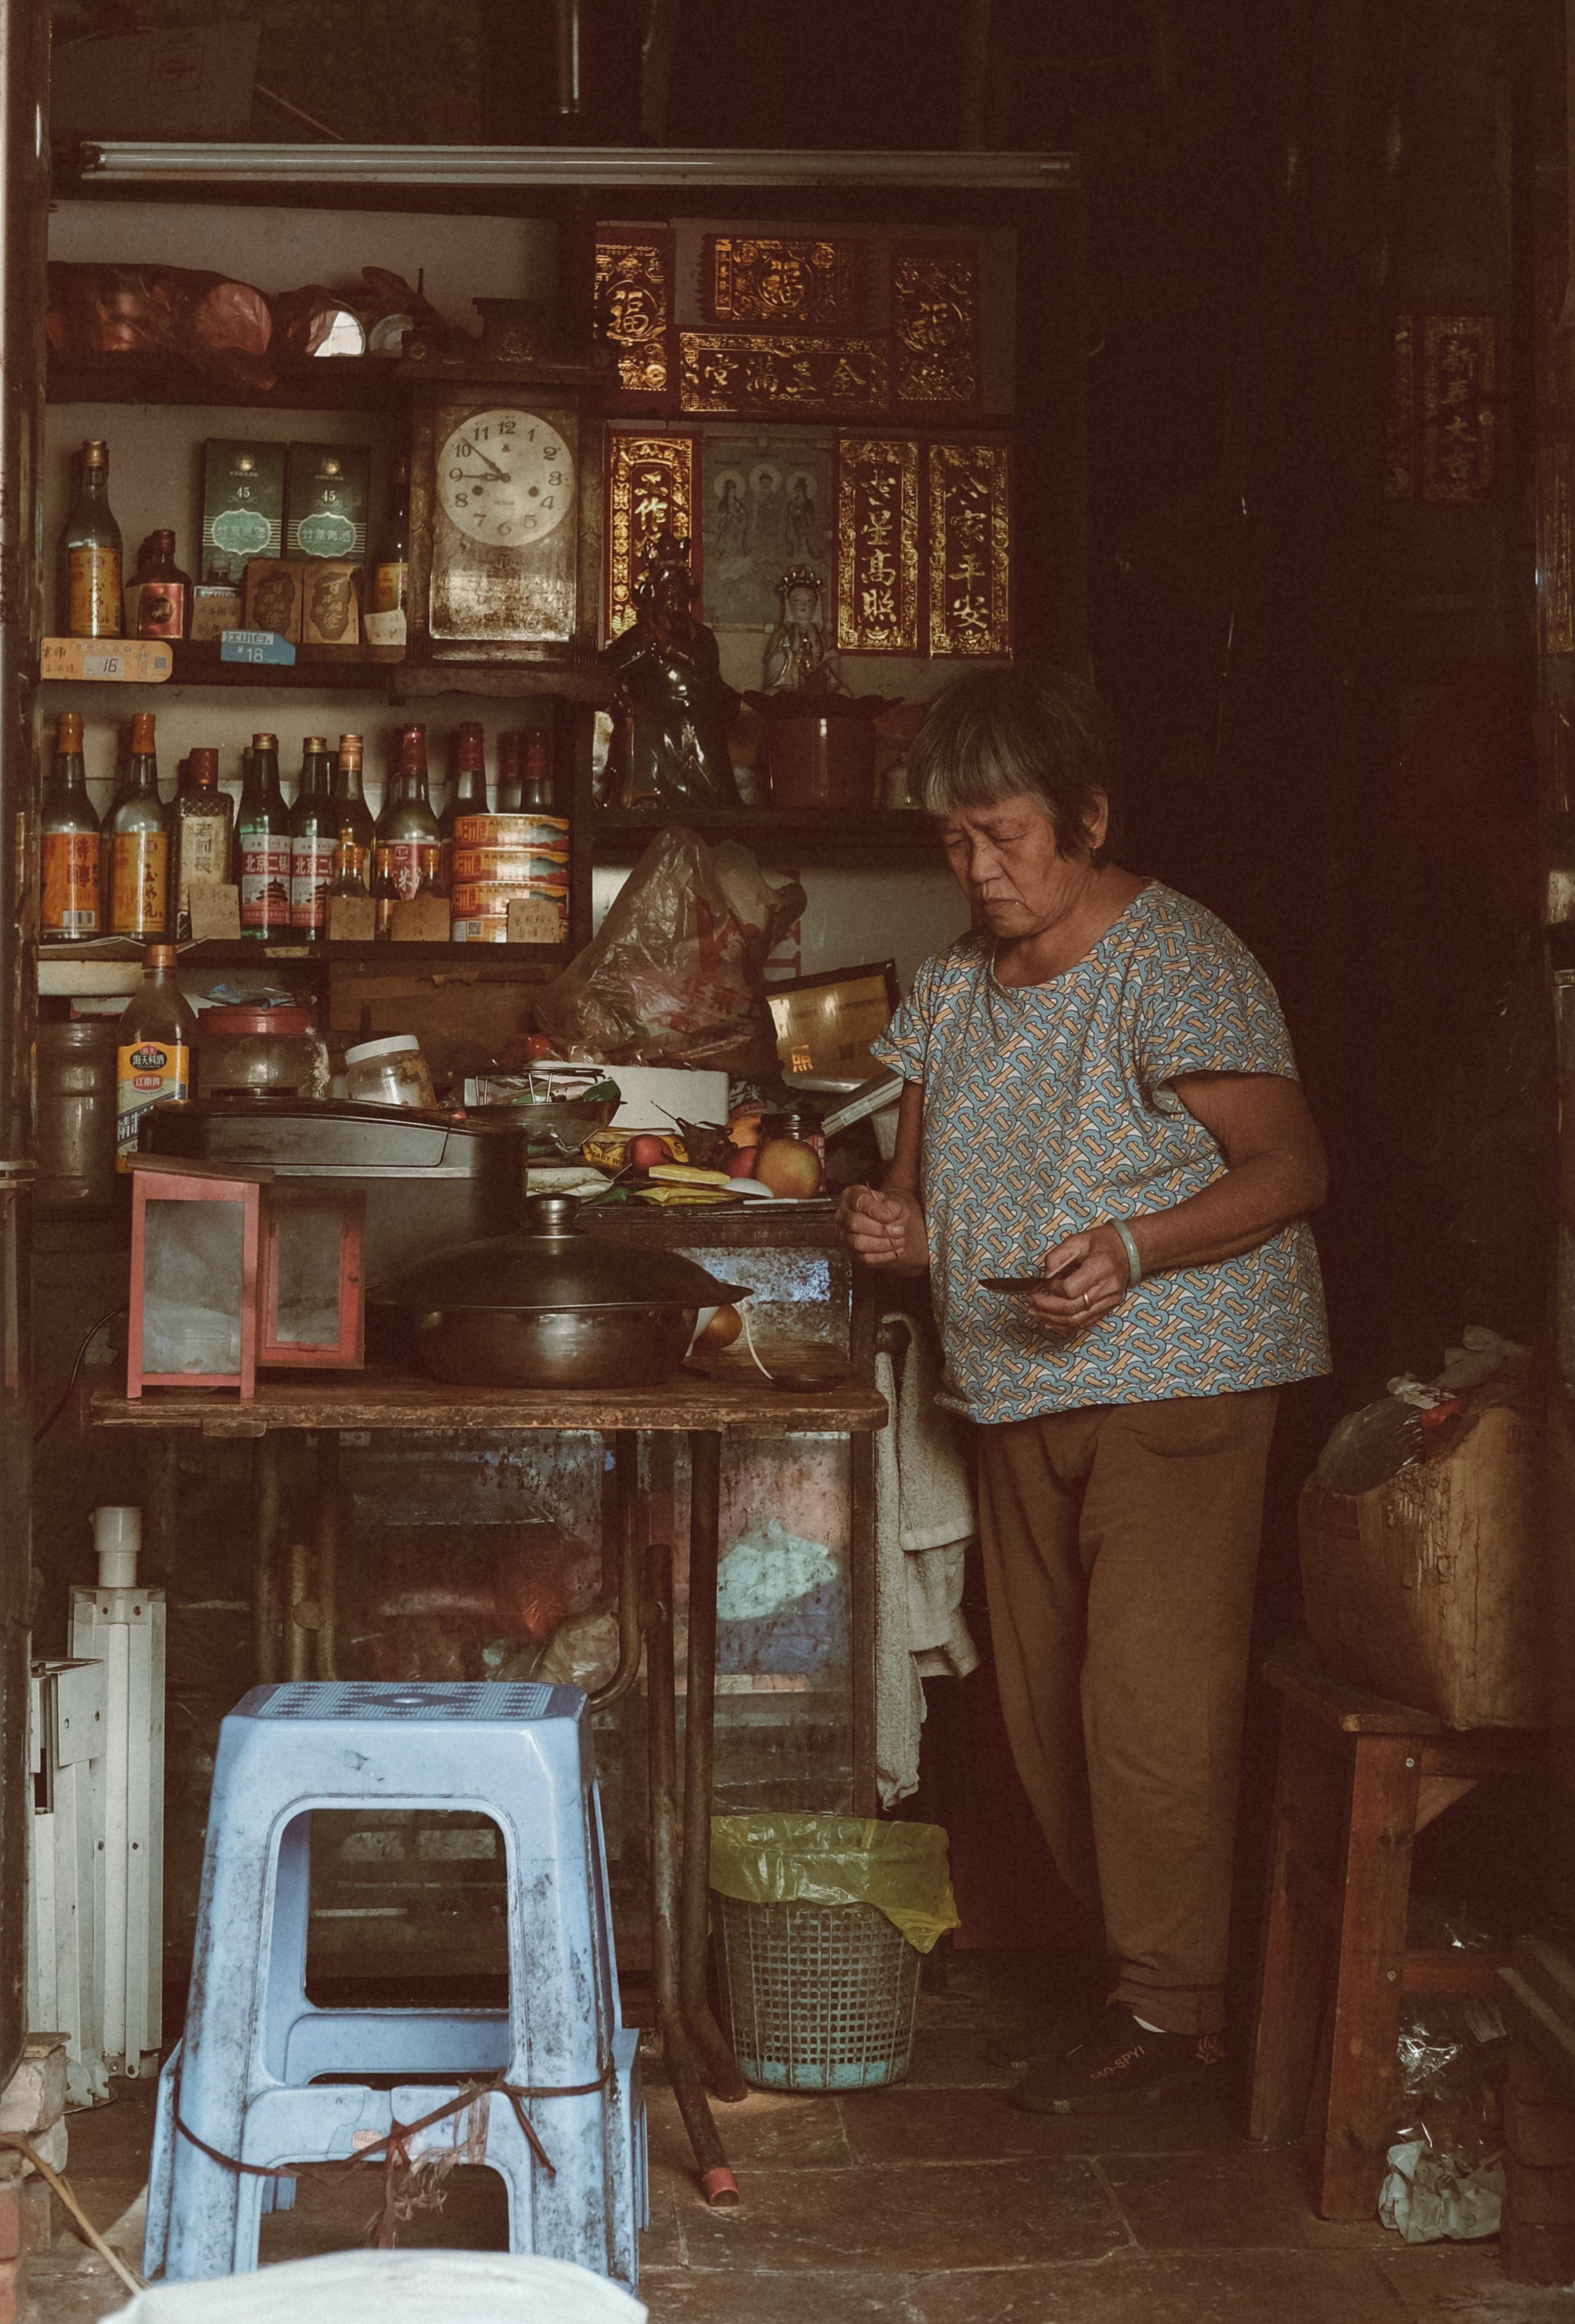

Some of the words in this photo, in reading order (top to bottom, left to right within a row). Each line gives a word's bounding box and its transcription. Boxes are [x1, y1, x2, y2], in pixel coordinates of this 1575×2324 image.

[609, 289, 651, 336] 福
[474, 426, 489, 441] 11
[498, 421, 516, 435] 12
[528, 428, 536, 442] 1
[454, 444, 472, 458] 10
[543, 446, 558, 461] 2
[449, 468, 464, 482] 9
[548, 471, 562, 486] 3
[236, 486, 250, 499] 45
[321, 490, 336, 502] 45
[454, 493, 469, 508] 8
[541, 495, 554, 510] 4
[473, 514, 487, 528] 7
[524, 514, 538, 529] 5
[497, 522, 512, 537] 6
[103, 658, 119, 673] 16
[245, 854, 290, 874] 北京二锅
[295, 857, 333, 876] 北京二
[132, 1054, 165, 1066] 海天料酒
